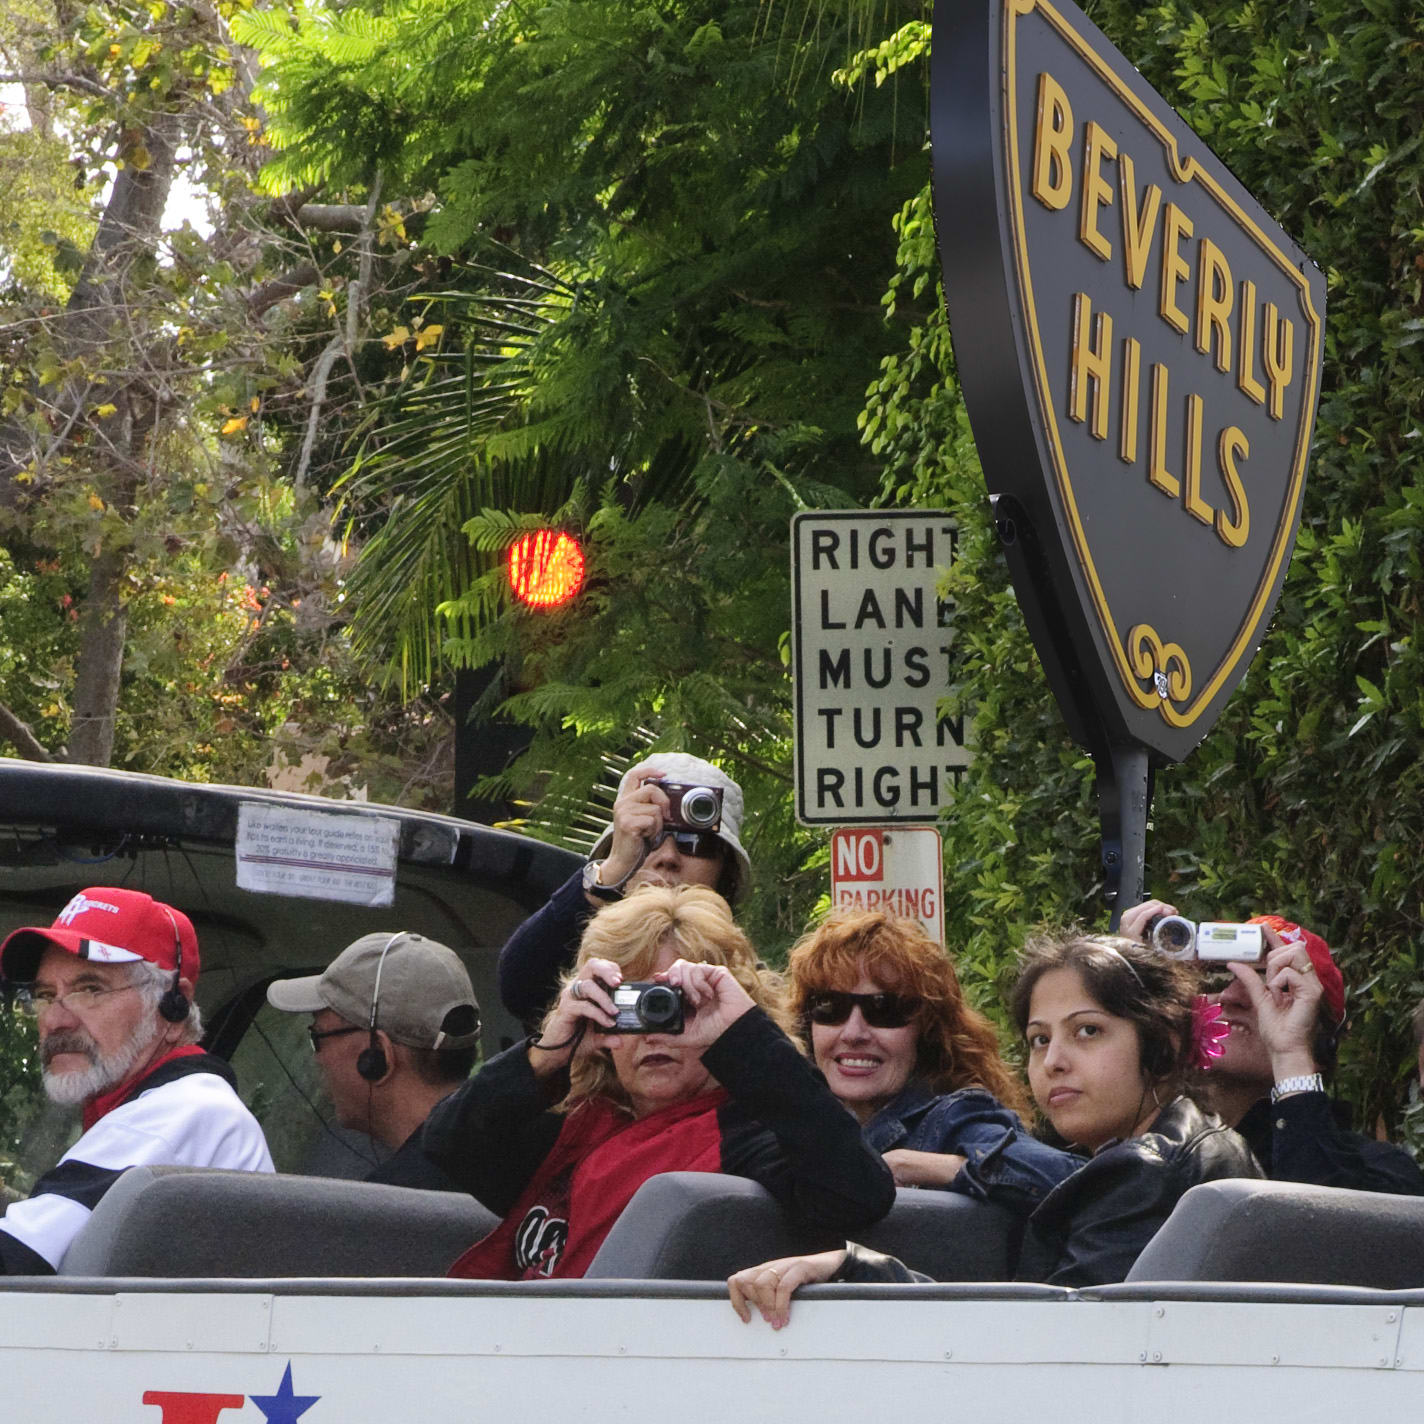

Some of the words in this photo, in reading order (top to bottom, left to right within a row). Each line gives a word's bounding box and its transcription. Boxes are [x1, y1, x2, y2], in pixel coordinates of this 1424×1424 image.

[1032, 72, 1294, 421] BEVERLY
[1069, 292, 1250, 549] HILLS
[812, 526, 959, 571] RIGHT
[818, 706, 965, 748] TURN
[817, 764, 968, 808] RIGHT
[837, 835, 880, 876] NO
